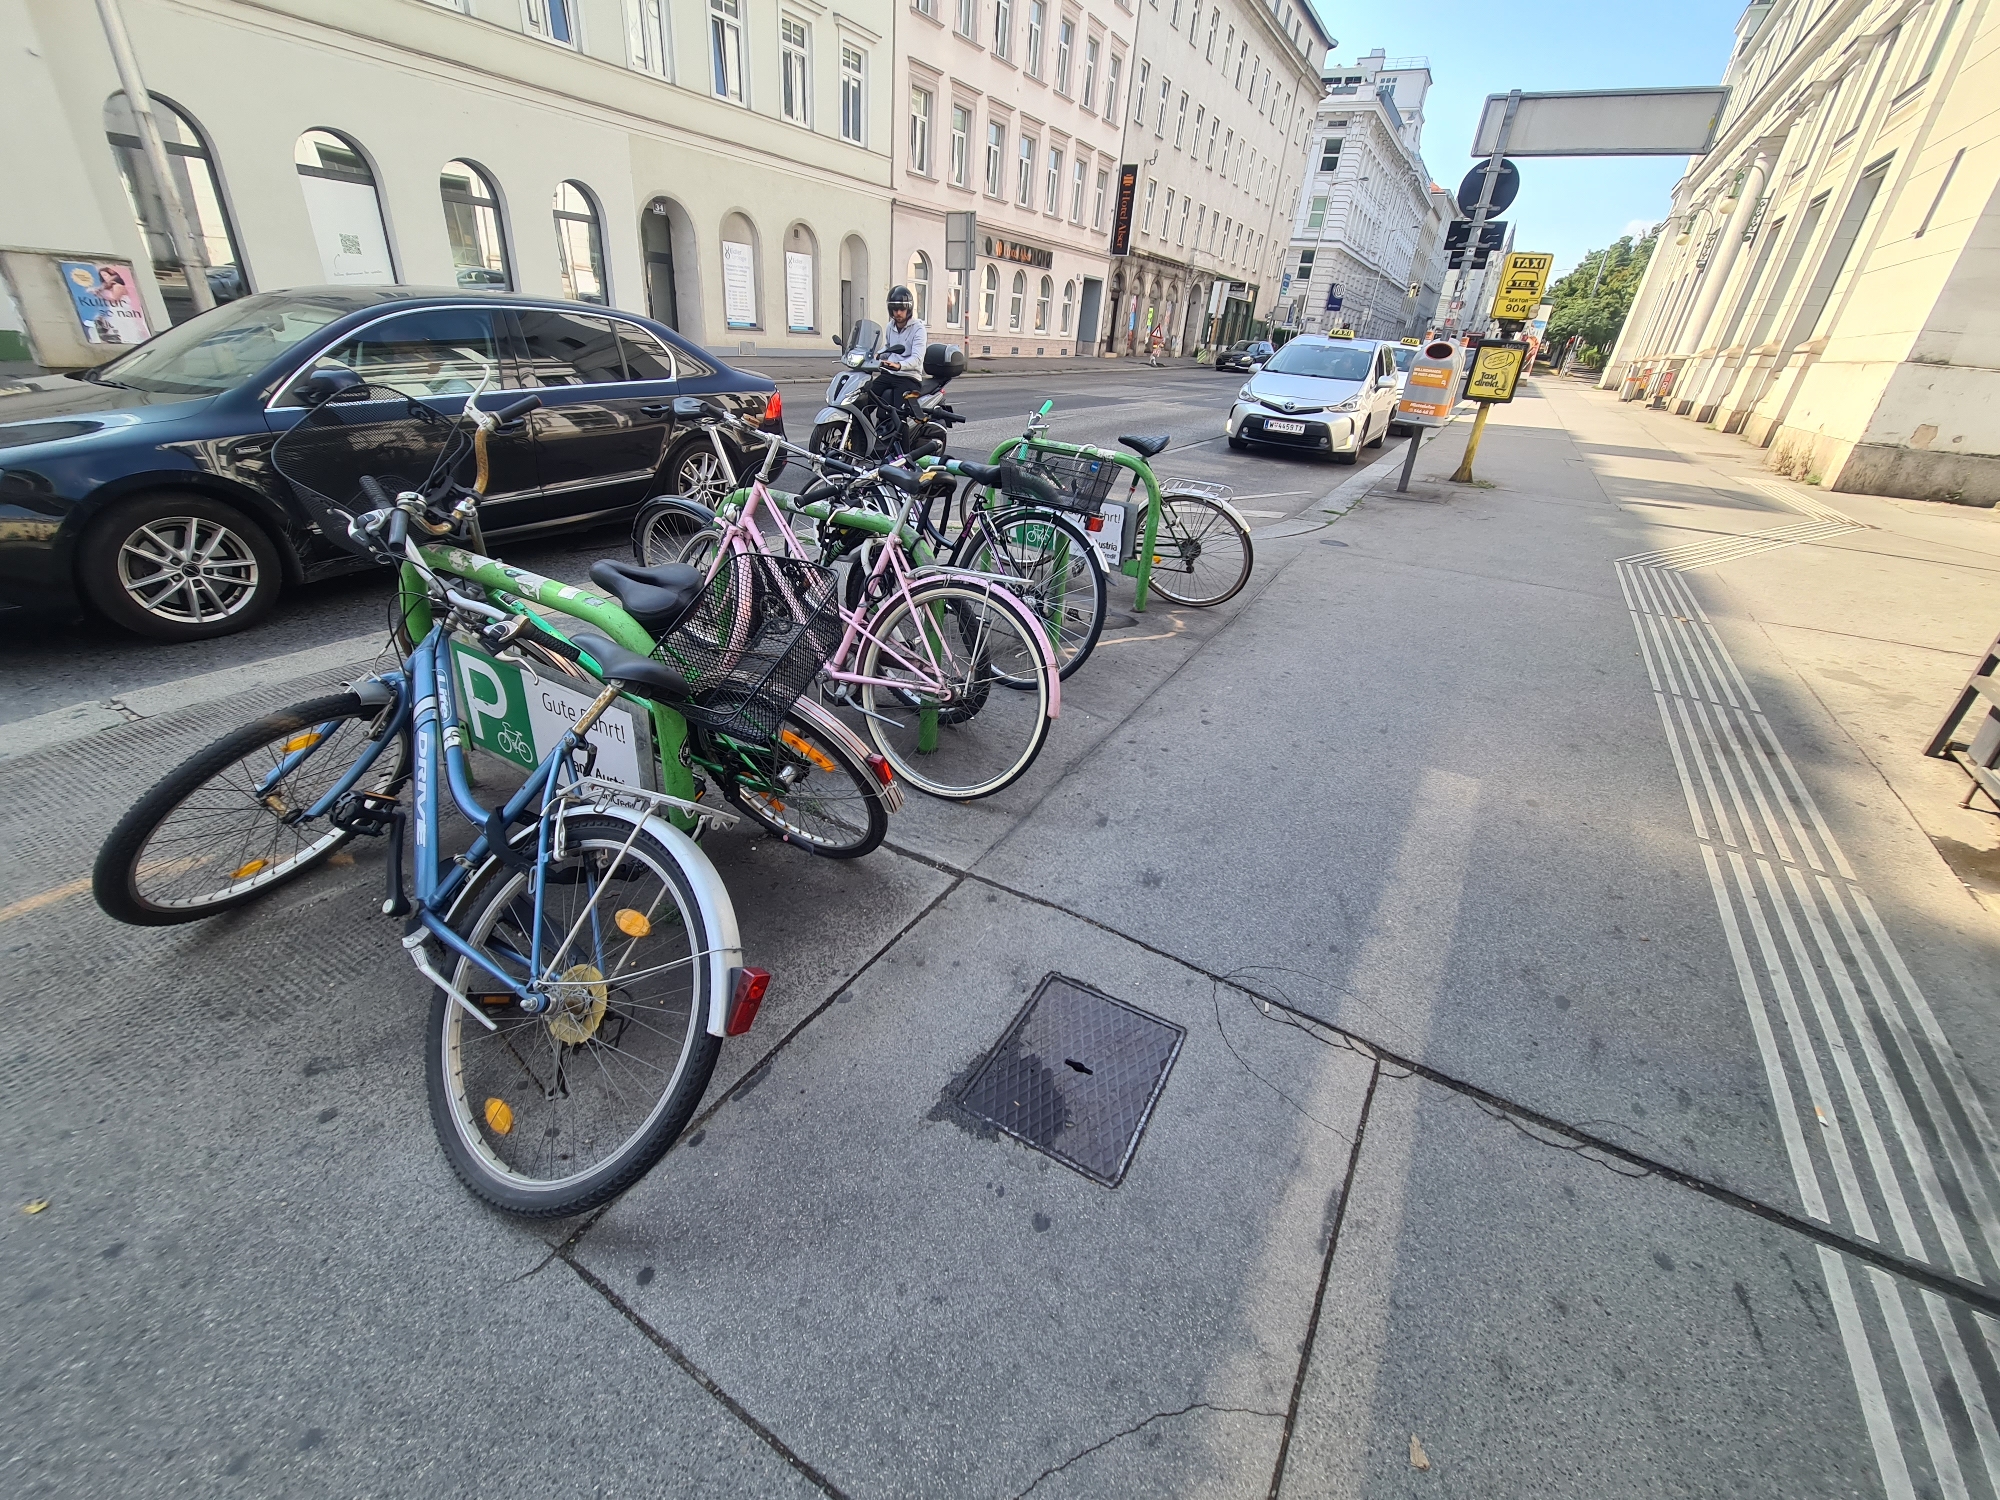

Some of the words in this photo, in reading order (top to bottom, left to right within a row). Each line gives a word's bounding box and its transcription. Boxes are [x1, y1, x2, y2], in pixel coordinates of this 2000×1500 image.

[655, 203, 664, 212] 34
[1120, 190, 1132, 220] Hotel
[1117, 221, 1128, 249] Alser
[1515, 258, 1546, 269] TAXI
[78, 296, 127, 307] Kultur
[117, 309, 142, 319] nah
[1505, 304, 1526, 313] 904
[1481, 372, 1498, 380] Taxi
[1098, 540, 1118, 551] ustria
[456, 650, 508, 741] P
[541, 692, 576, 722] Gute
[416, 731, 428, 848] DRIVE
